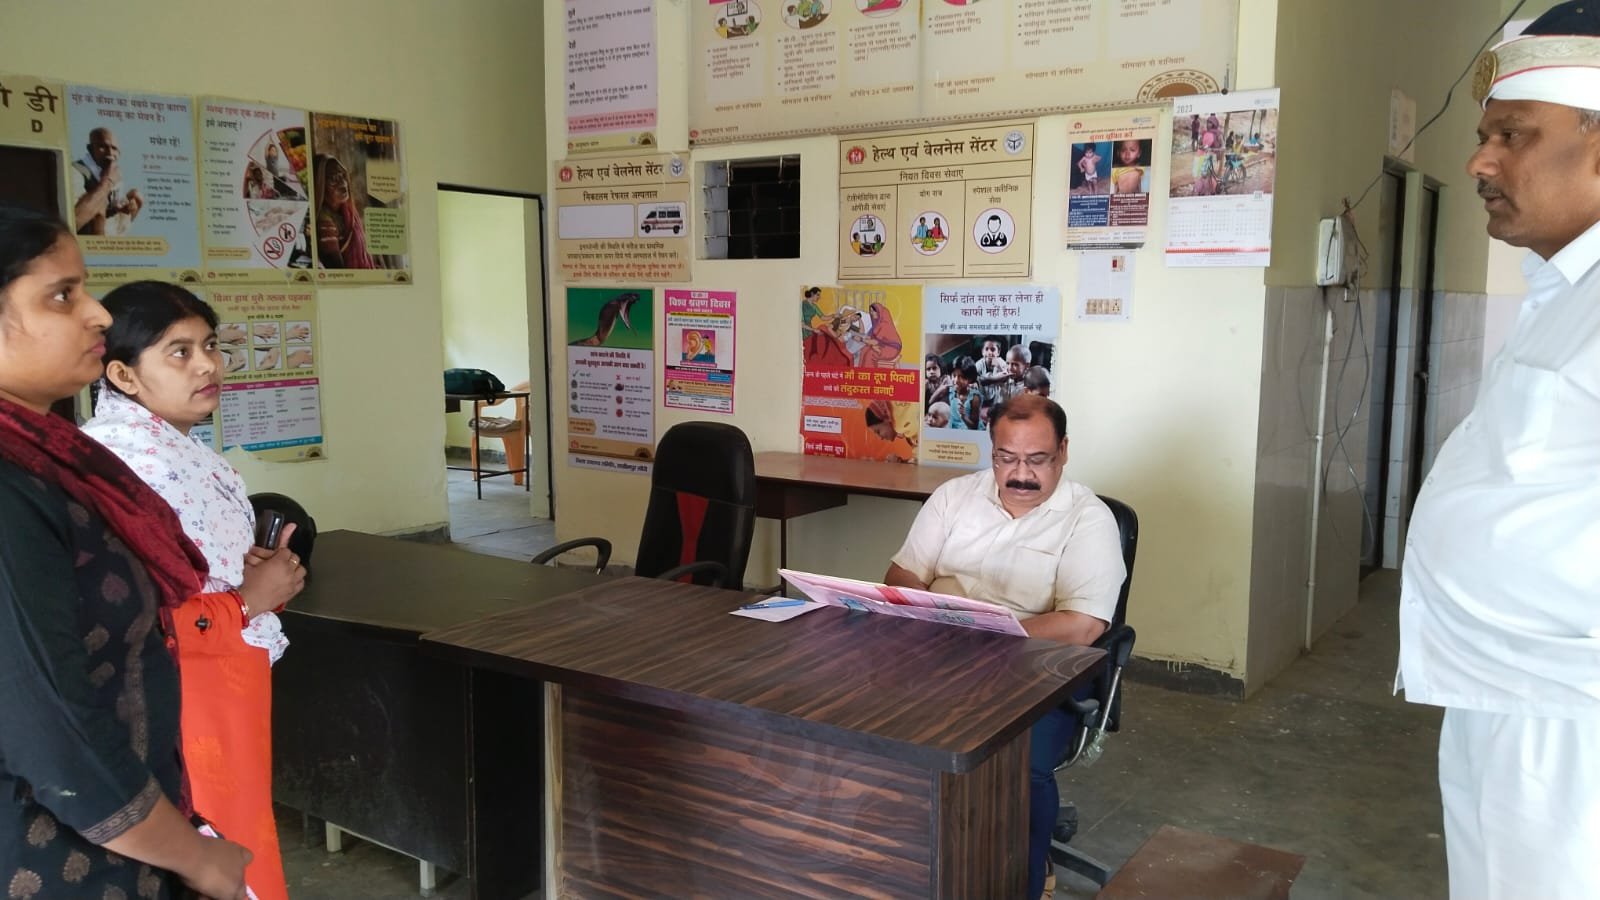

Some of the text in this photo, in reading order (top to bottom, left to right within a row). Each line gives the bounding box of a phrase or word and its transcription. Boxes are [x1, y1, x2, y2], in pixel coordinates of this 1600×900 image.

[24, 85, 58, 114] डी
[1176, 104, 1193, 114] 2023
[32, 119, 43, 133] D
[872, 136, 998, 163] हेल्थ एवं वेलनेस सेंटर
[576, 166, 594, 181] हेल्थ
[597, 165, 610, 181] एवं
[613, 162, 642, 177] वेलनेस
[940, 291, 958, 304] सिर्फ
[960, 292, 975, 303] दांत
[998, 294, 1013, 303] कर
[1014, 291, 1033, 303] लेना
[1034, 291, 1044, 304] ही
[960, 305, 983, 317] काफी
[986, 305, 1000, 318] नहीं
[858, 372, 871, 381] का
[874, 372, 887, 385] दूध
